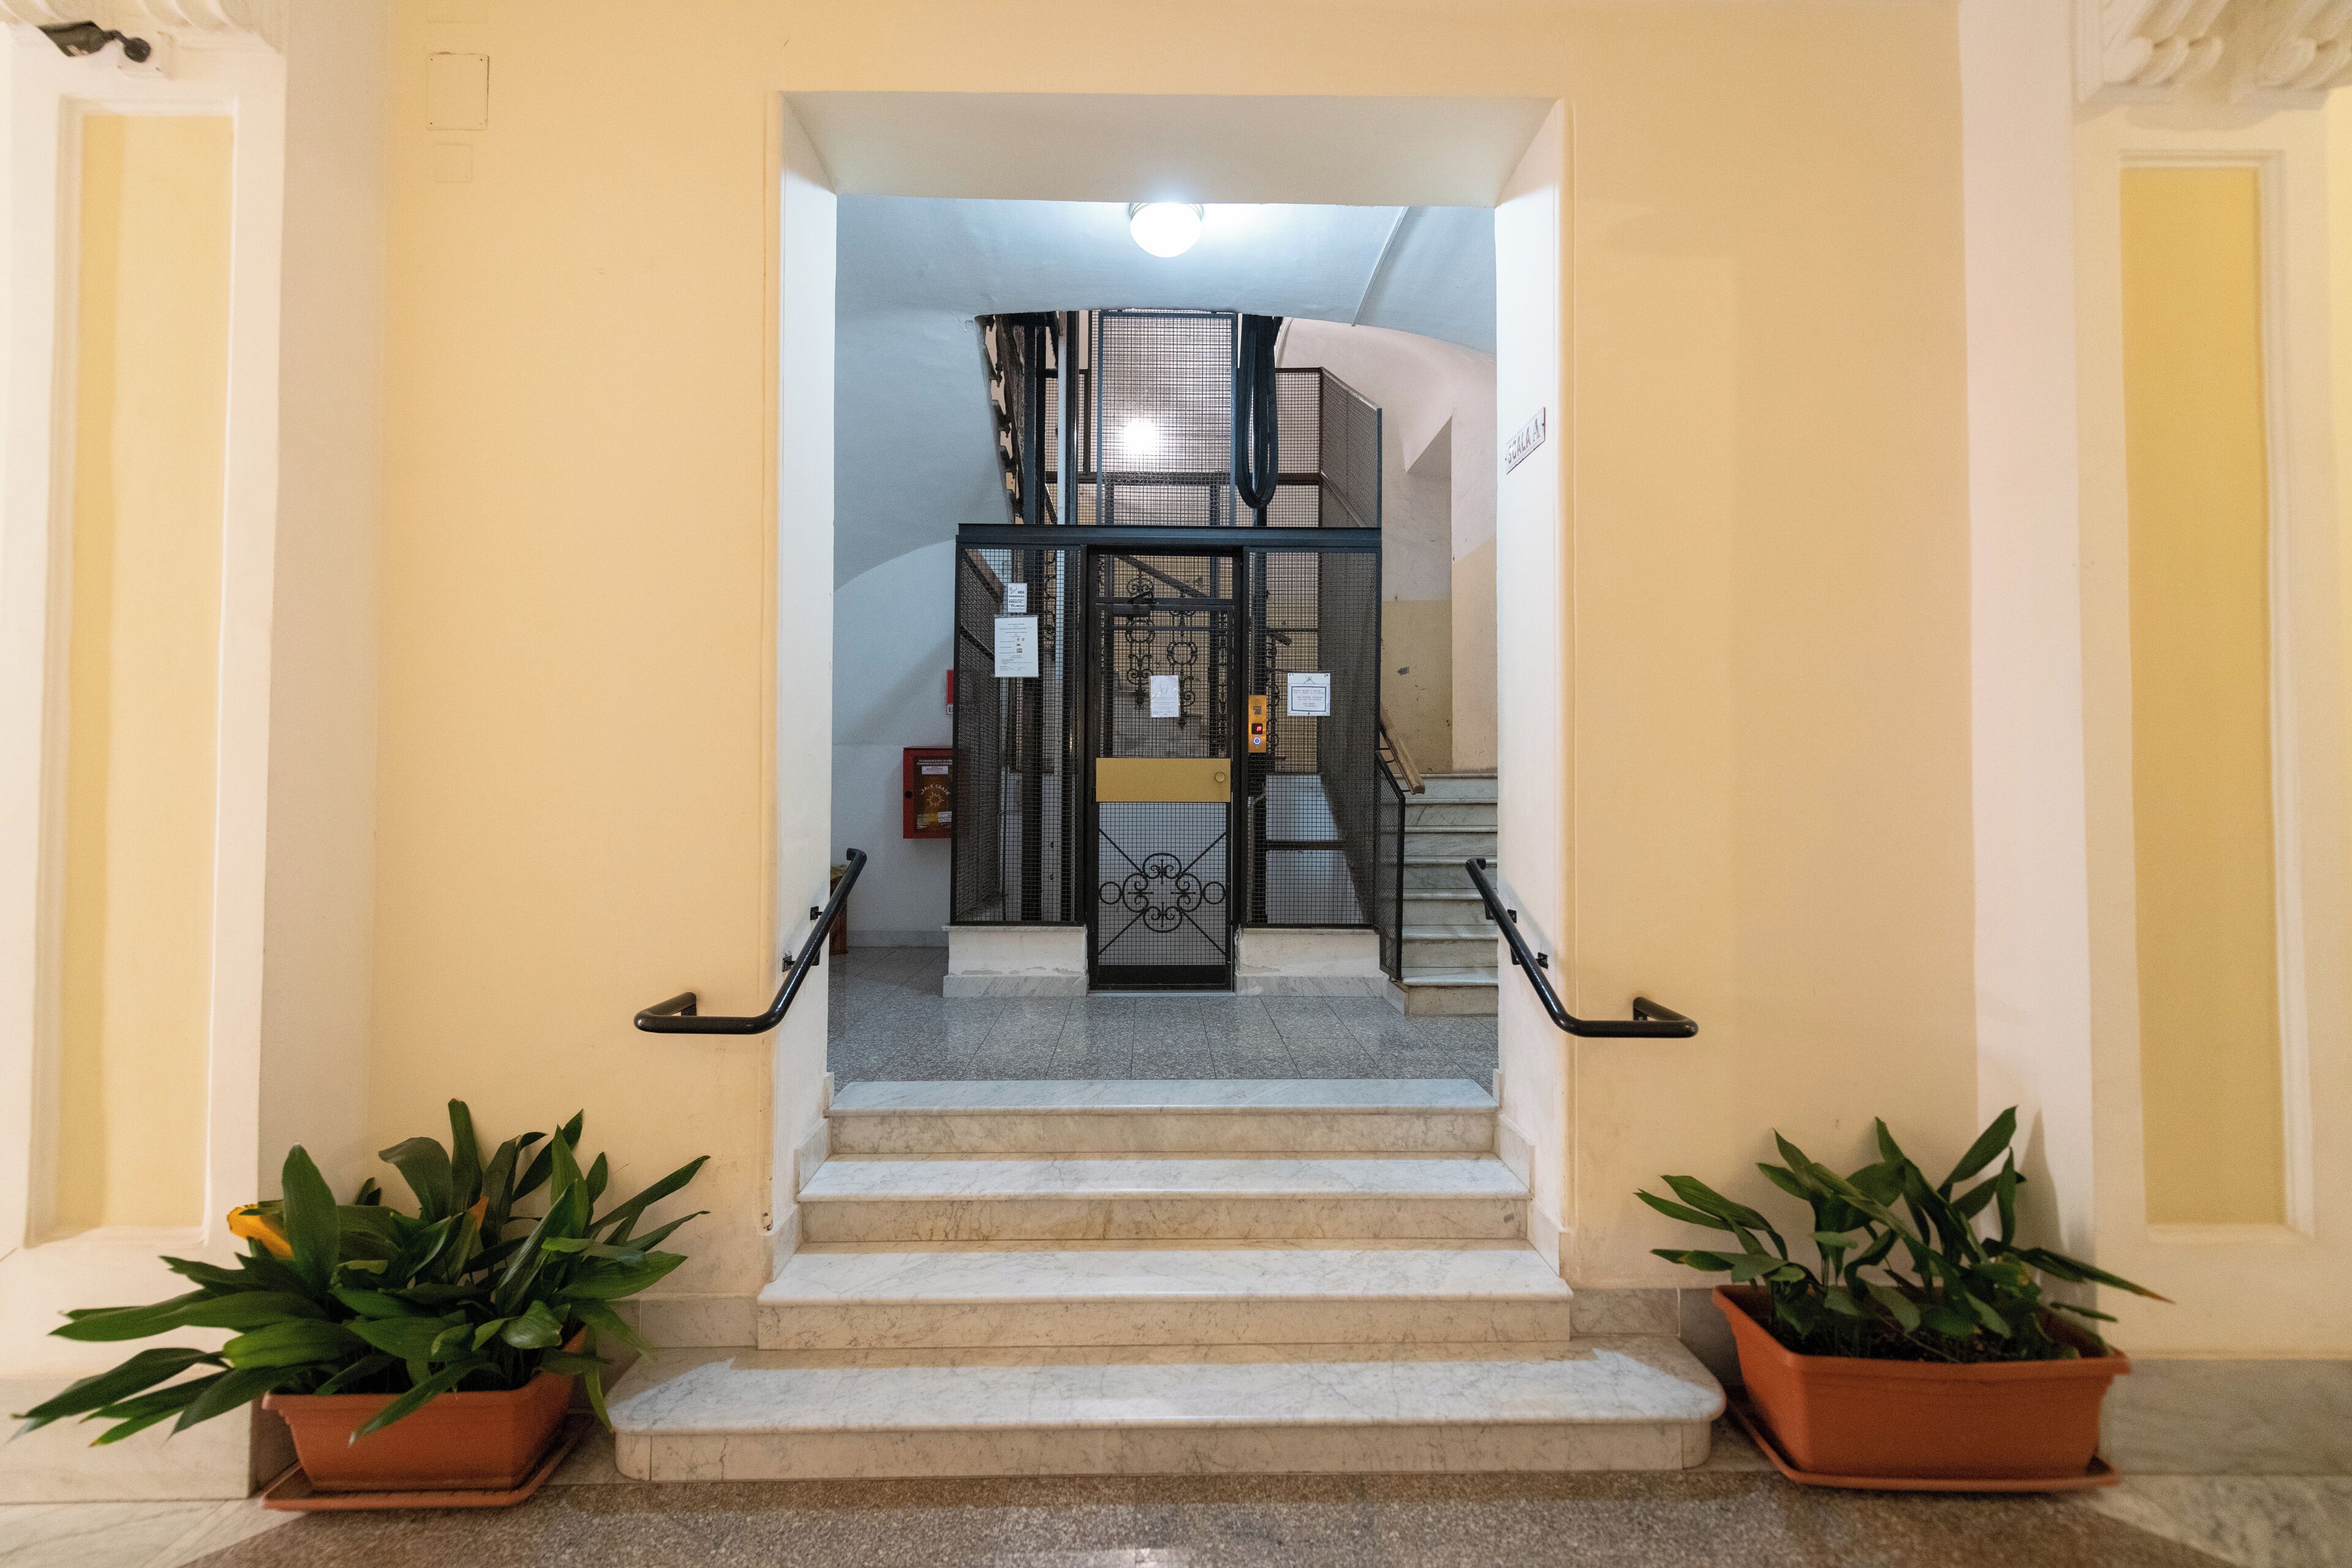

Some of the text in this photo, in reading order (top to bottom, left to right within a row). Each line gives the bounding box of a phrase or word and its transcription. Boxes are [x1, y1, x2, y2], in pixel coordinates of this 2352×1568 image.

[1508, 418, 1540, 464] SCALA A
[935, 784, 952, 796] CRASH
